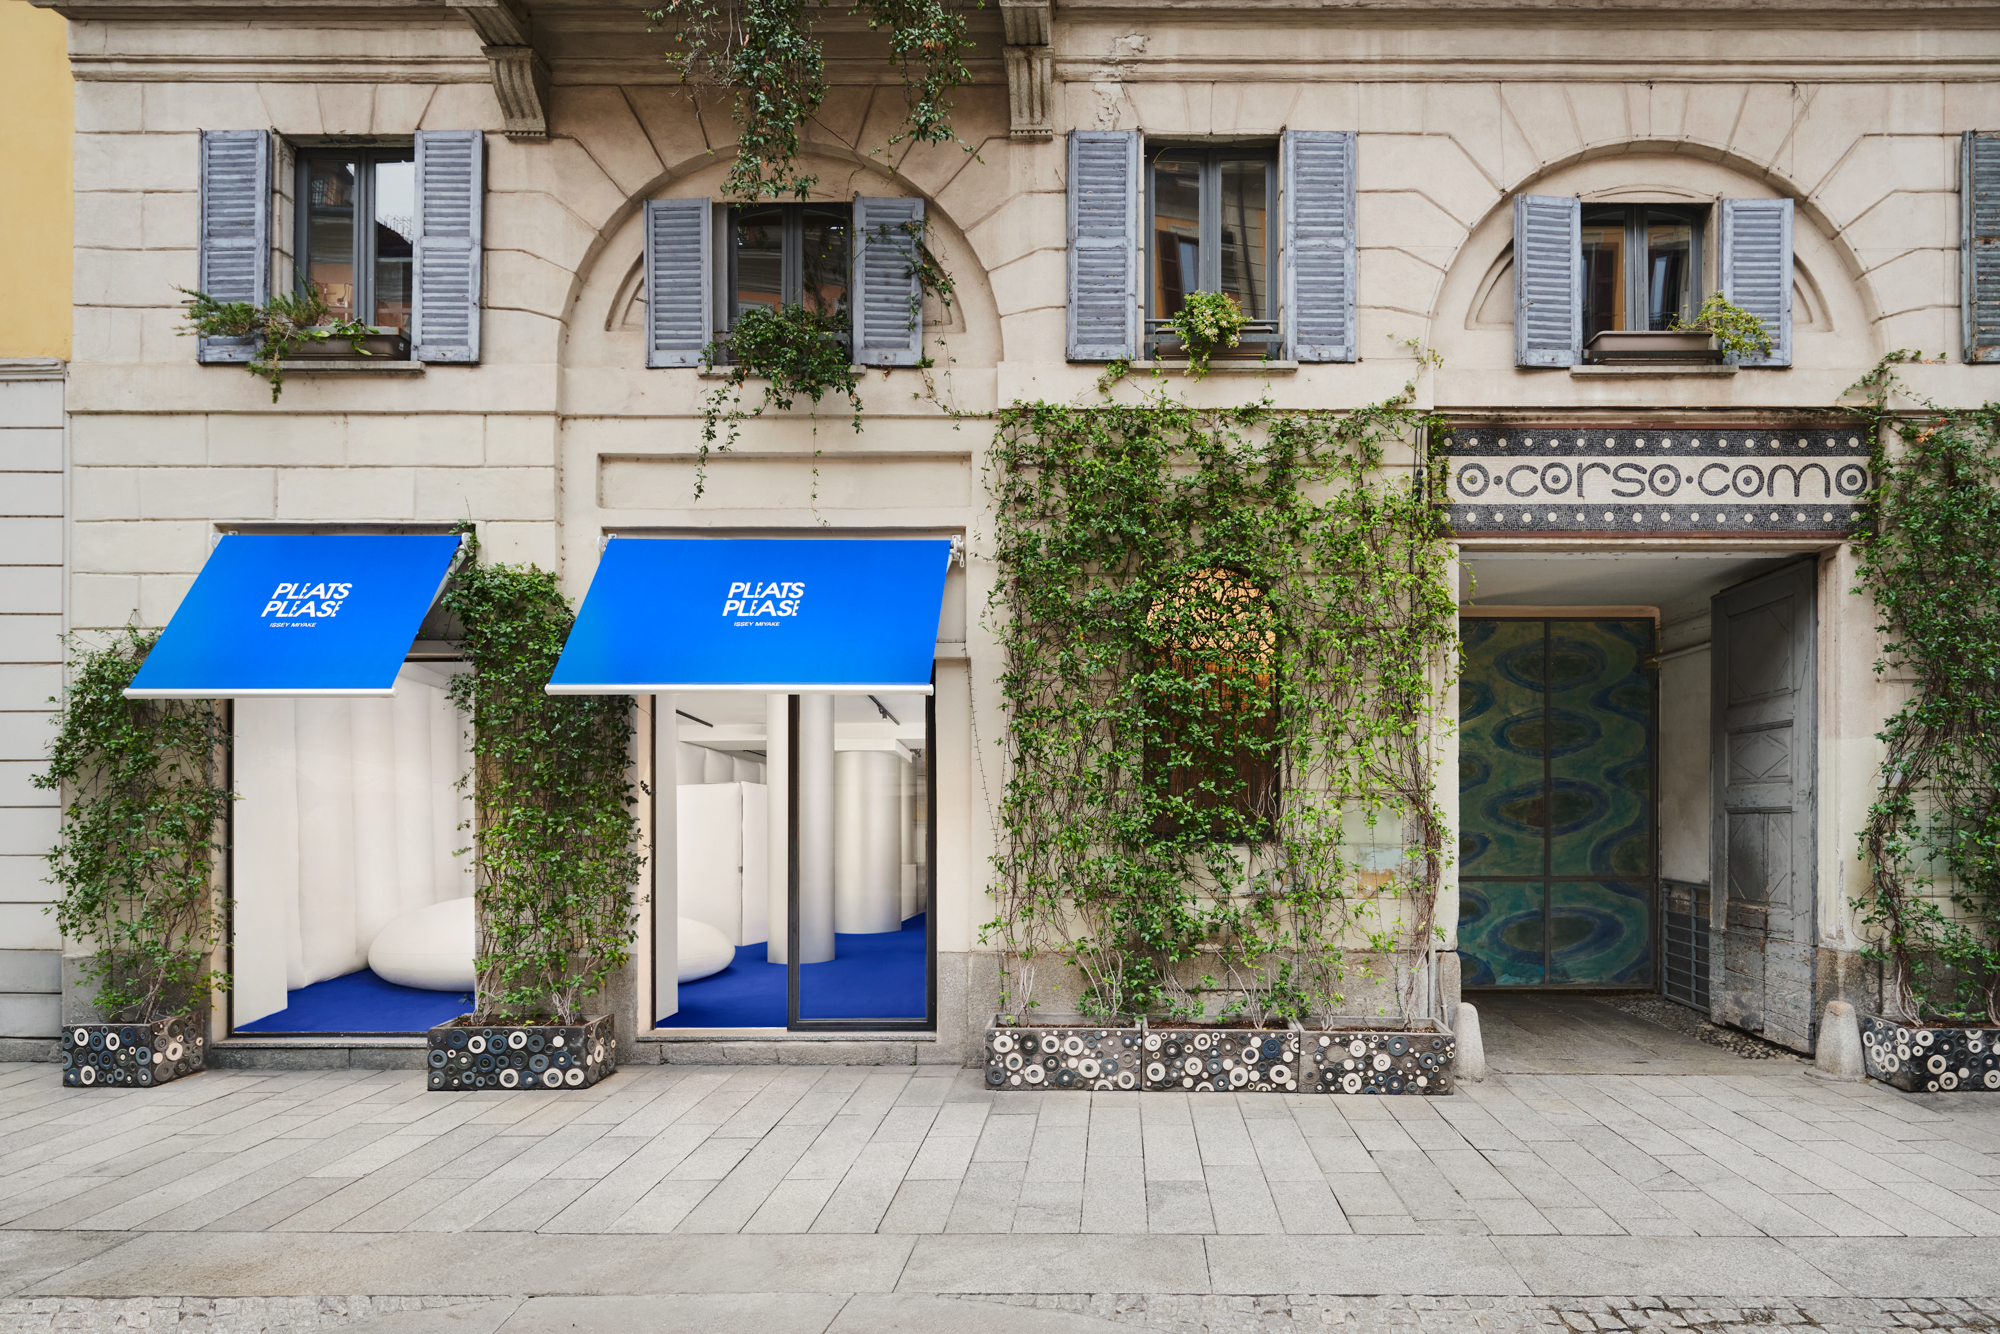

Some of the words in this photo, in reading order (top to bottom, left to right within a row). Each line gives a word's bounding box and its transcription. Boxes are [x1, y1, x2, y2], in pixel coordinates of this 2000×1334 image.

[271, 582, 353, 600] PLEATS
[727, 581, 806, 599] PLEATS
[260, 600, 344, 618] PLEASE
[721, 599, 801, 617] PLEASE
